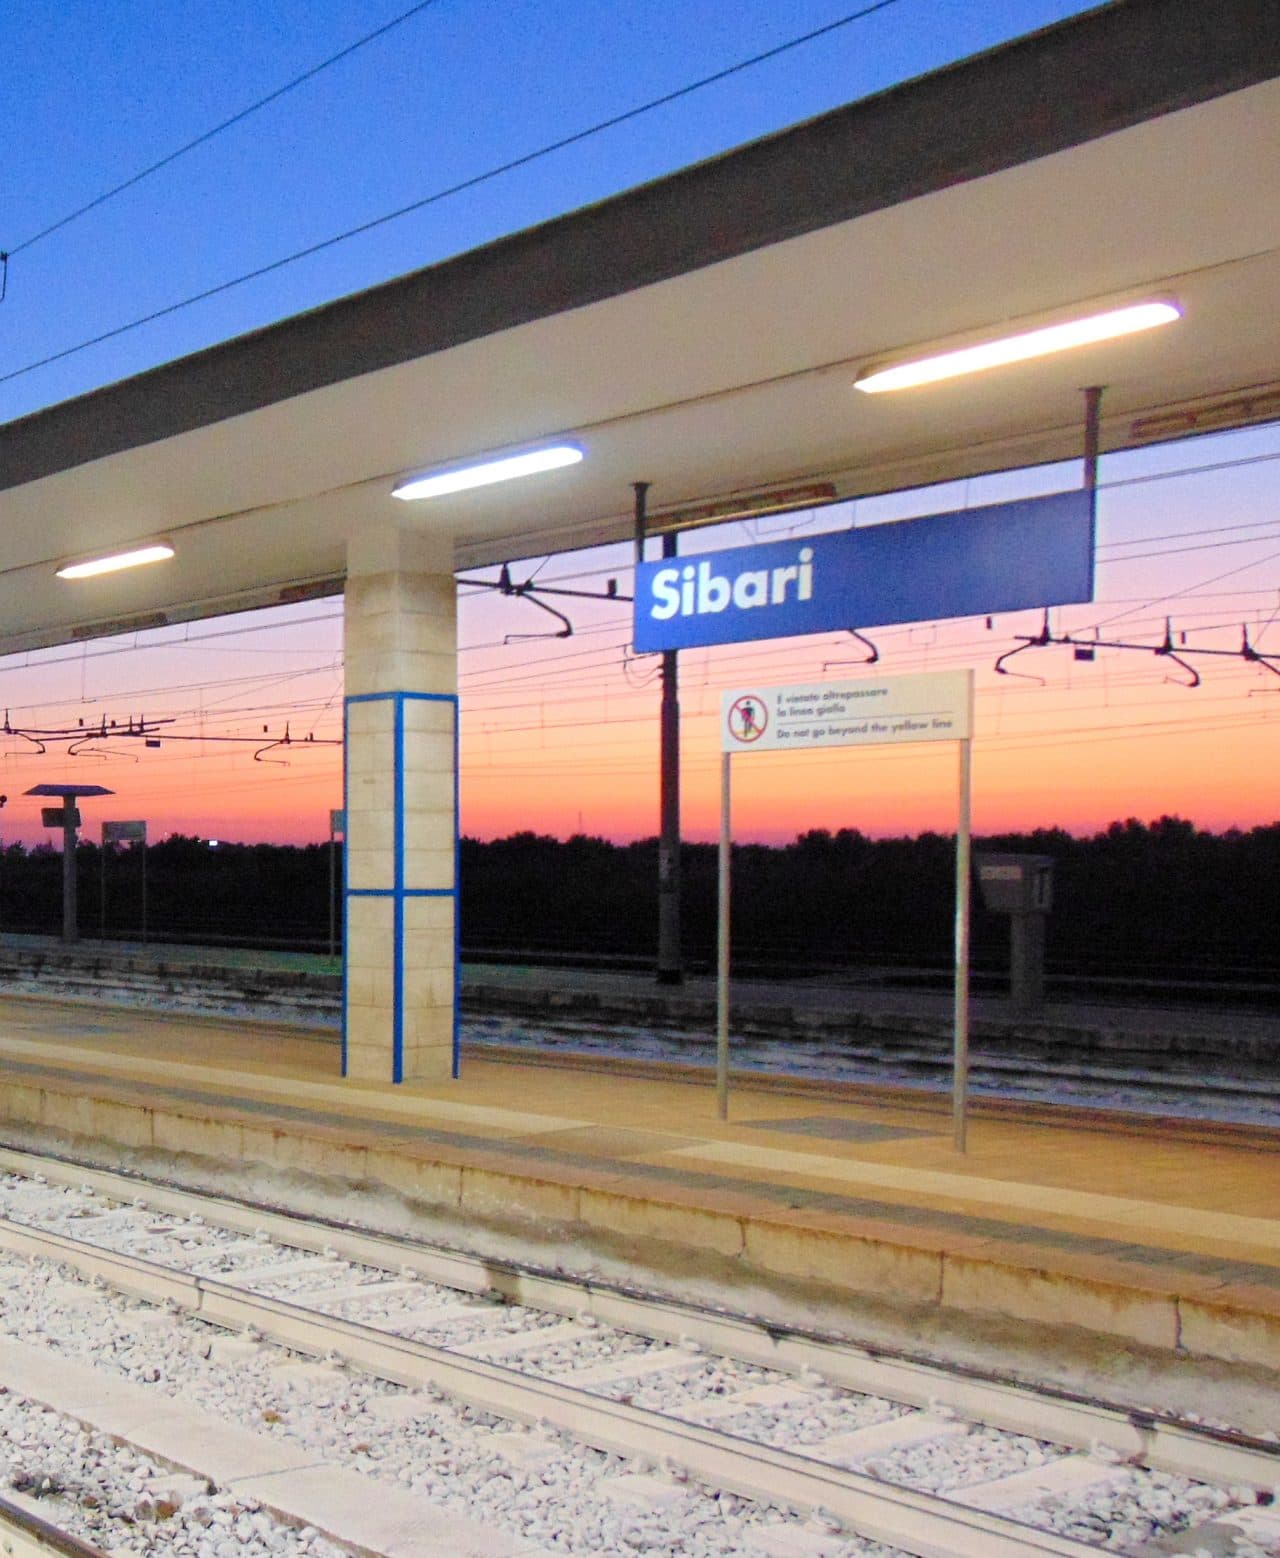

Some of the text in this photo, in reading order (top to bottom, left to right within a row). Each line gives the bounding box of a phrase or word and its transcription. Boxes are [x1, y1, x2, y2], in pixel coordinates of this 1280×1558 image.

[650, 547, 814, 620] Sibari
[786, 693, 819, 704] vietato
[777, 702, 846, 718] la linea gialla
[777, 717, 952, 739] Do not go beyond the yellow line
